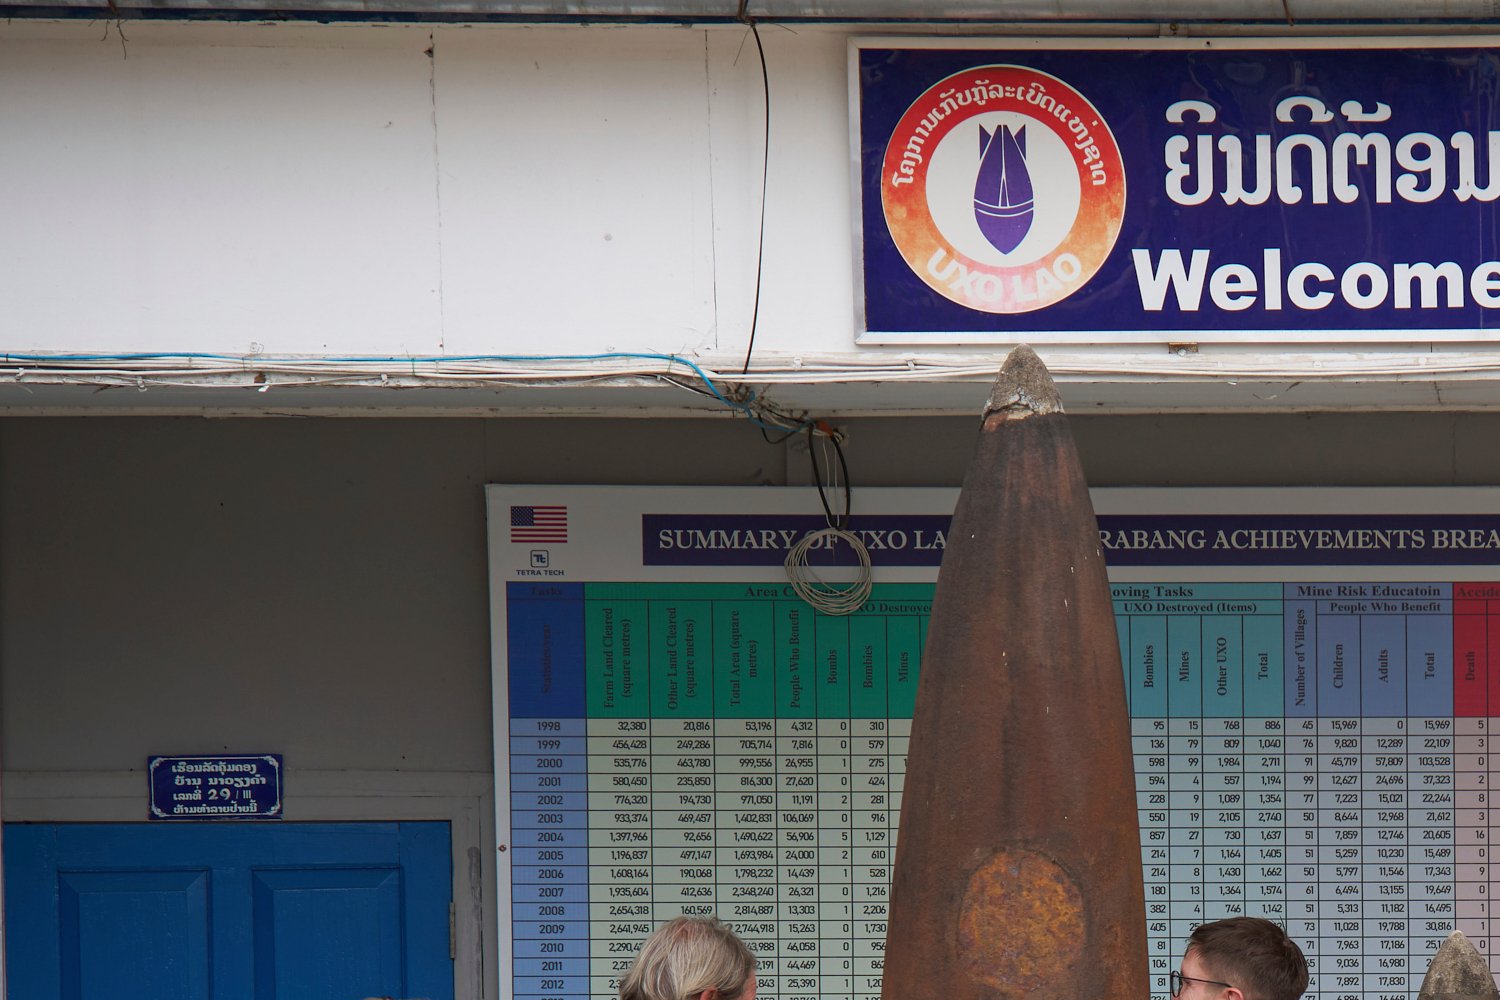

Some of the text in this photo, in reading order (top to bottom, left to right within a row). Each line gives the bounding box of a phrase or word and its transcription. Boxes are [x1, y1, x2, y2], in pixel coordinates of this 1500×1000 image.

[926, 248, 1083, 302] UXO LAO
[659, 529, 948, 550] SUMMARY OF UXO LA
[1099, 529, 1207, 550] RABANG
[1212, 528, 1426, 550] ACHIEVEMENTS
[744, 586, 780, 598] Area
[1112, 586, 1193, 600] oving Tasks
[1297, 585, 1441, 597] Mine Risk Educatoin
[1124, 602, 1258, 614] UXO Destroyed (Items)
[1329, 602, 1442, 614] People Who Benefit
[602, 607, 613, 648] Cleared
[603, 651, 614, 677] Land
[620, 619, 633, 698] (square metres)
[666, 607, 678, 710] Other Land Cleared
[684, 619, 697, 698] (square metres)
[729, 610, 741, 707] Total Area (square
[746, 640, 758, 678] metres)
[789, 609, 802, 708] People Who Benefit
[827, 648, 838, 685] Bombs
[863, 644, 874, 688] Bombies
[899, 651, 909, 682] Mines
[1144, 644, 1154, 688] Bombies
[1180, 651, 1190, 682] Mines
[1217, 636, 1227, 696] Other UXO
[1258, 652, 1269, 679] Total
[1295, 609, 1307, 706] Number of Villages
[1333, 643, 1344, 689] Children
[1379, 648, 1389, 683] Adults
[1425, 652, 1435, 679] Total
[1466, 651, 1476, 681] Death
[536, 721, 561, 732] 1998
[617, 721, 647, 733] 32,380
[745, 720, 773, 733] 53,196
[1331, 719, 1358, 732] 15,969
[536, 758, 563, 769] 2000
[1418, 756, 1451, 768] 103,528
[207, 788, 231, 801] 29
[536, 832, 565, 843] 2004
[538, 905, 565, 916] 2008
